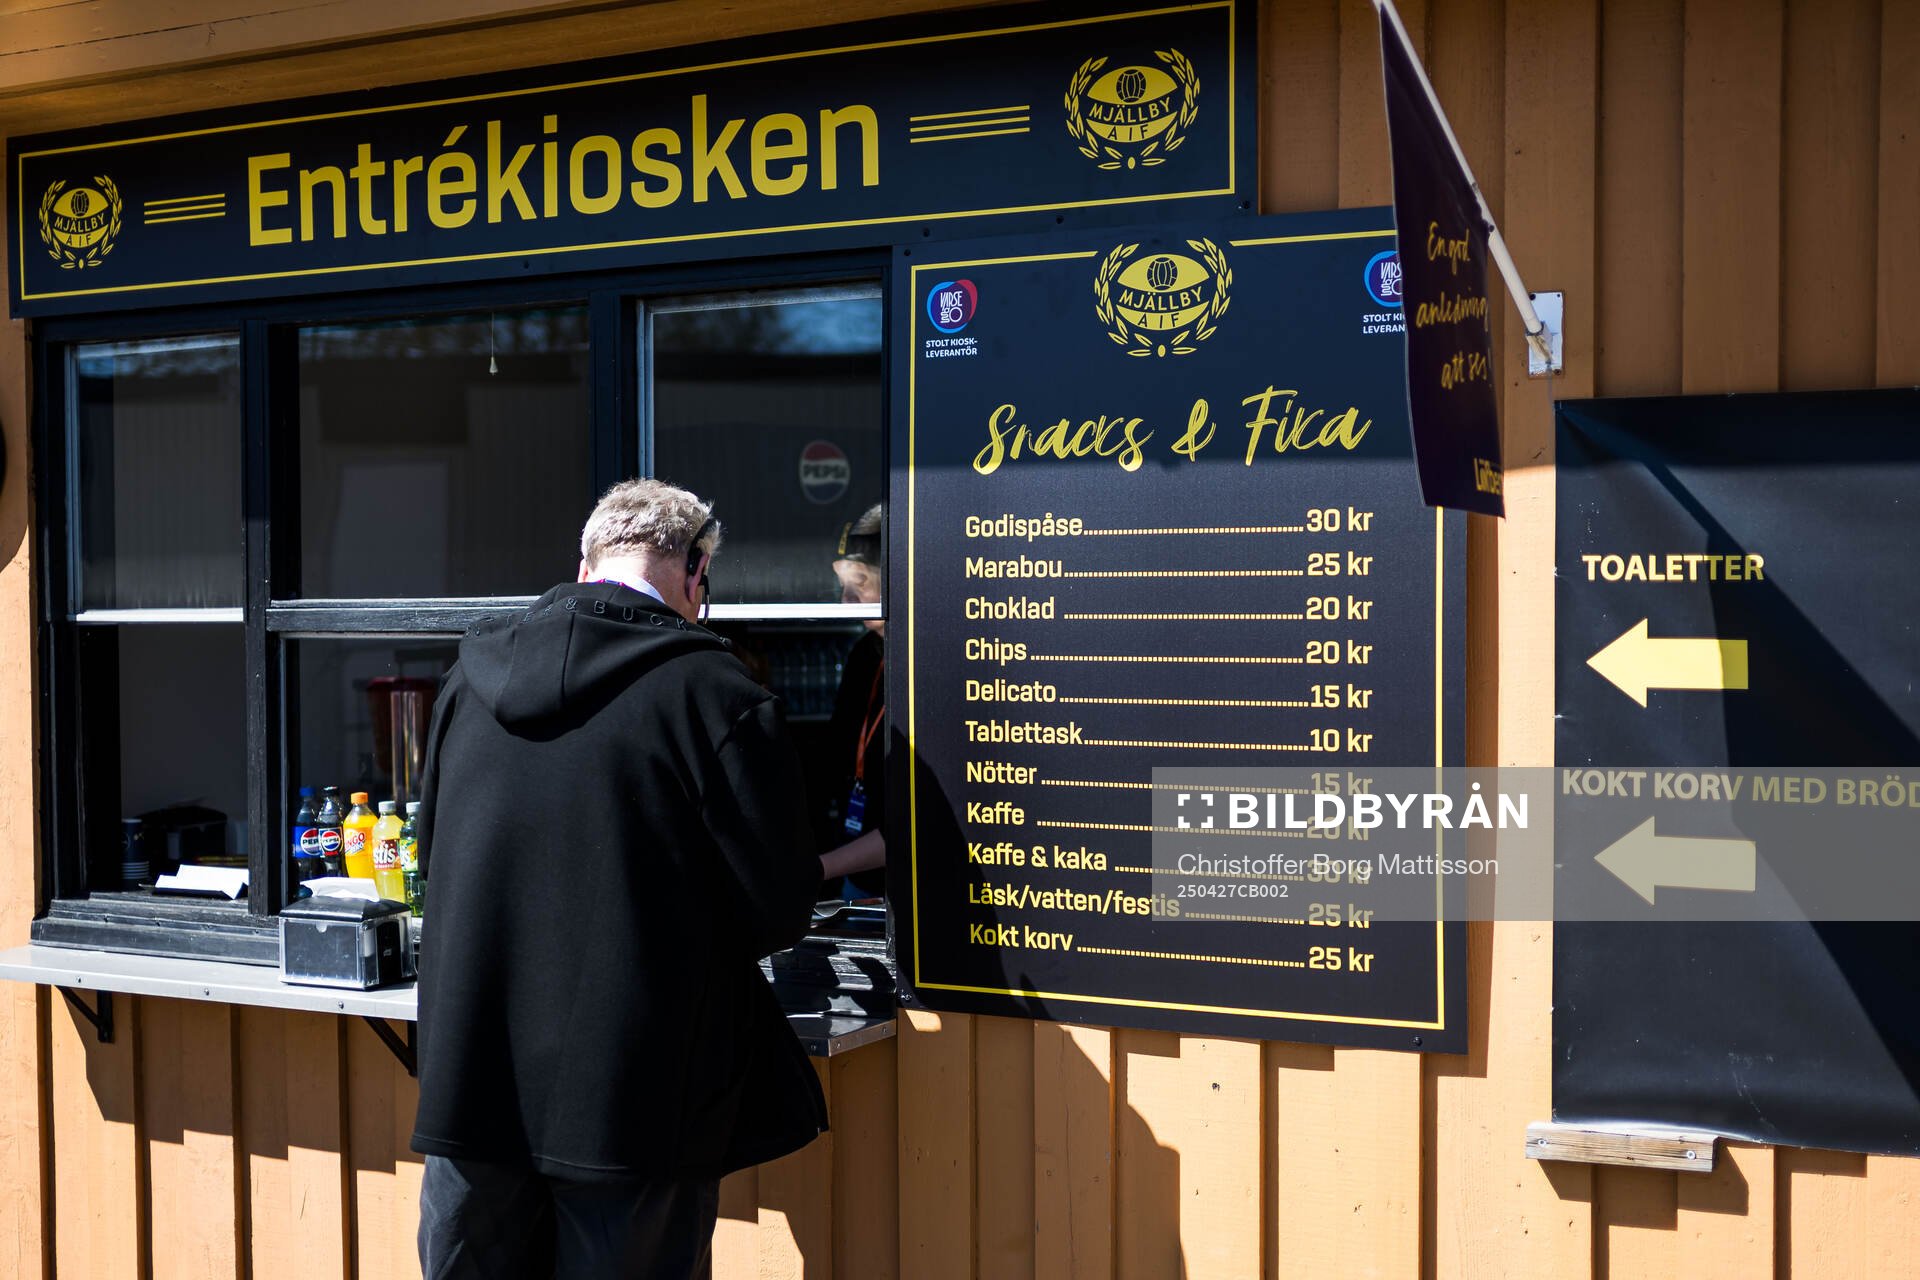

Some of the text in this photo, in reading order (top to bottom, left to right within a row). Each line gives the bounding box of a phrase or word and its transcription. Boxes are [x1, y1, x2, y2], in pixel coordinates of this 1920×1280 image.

[1088, 96, 1171, 123] MJÄLLBY
[248, 94, 880, 246] Entrékiosken
[54, 212, 105, 233] MJÄLLBY
[1118, 285, 1202, 311] MJÄLLBY
[1363, 312, 1406, 323] STOLT KI
[925, 337, 978, 348] STOLT KIOSK-
[925, 346, 978, 358] LEVERANTÖR
[1171, 398, 1217, 463] &
[1242, 384, 1373, 467] Fika
[966, 506, 1373, 540] Godispåse 30 kr
[966, 550, 1373, 579] Marabou 25 kr
[1582, 553, 1765, 582] TOALETTER
[966, 594, 1373, 620] Choklad 20 kr
[966, 637, 1373, 667] Chips 20 kr
[966, 678, 1373, 709] Delicato 15 kr
[965, 719, 1373, 753] Tablettask 10 kr
[967, 760, 1038, 785] Nötter
[1311, 772, 1341, 797] 15
[1562, 769, 1647, 797] KOKT
[1654, 772, 1744, 801] KORV
[1752, 775, 1827, 804] MED
[967, 801, 1025, 826] Kaffe
[969, 842, 1026, 867] Kaffe
[1031, 846, 1049, 868] &
[1053, 845, 1107, 871] kaka
[968, 882, 1374, 929] Läsk/vatten/festis 25 kr
[970, 923, 1375, 973] Kokt korv 25 kr
